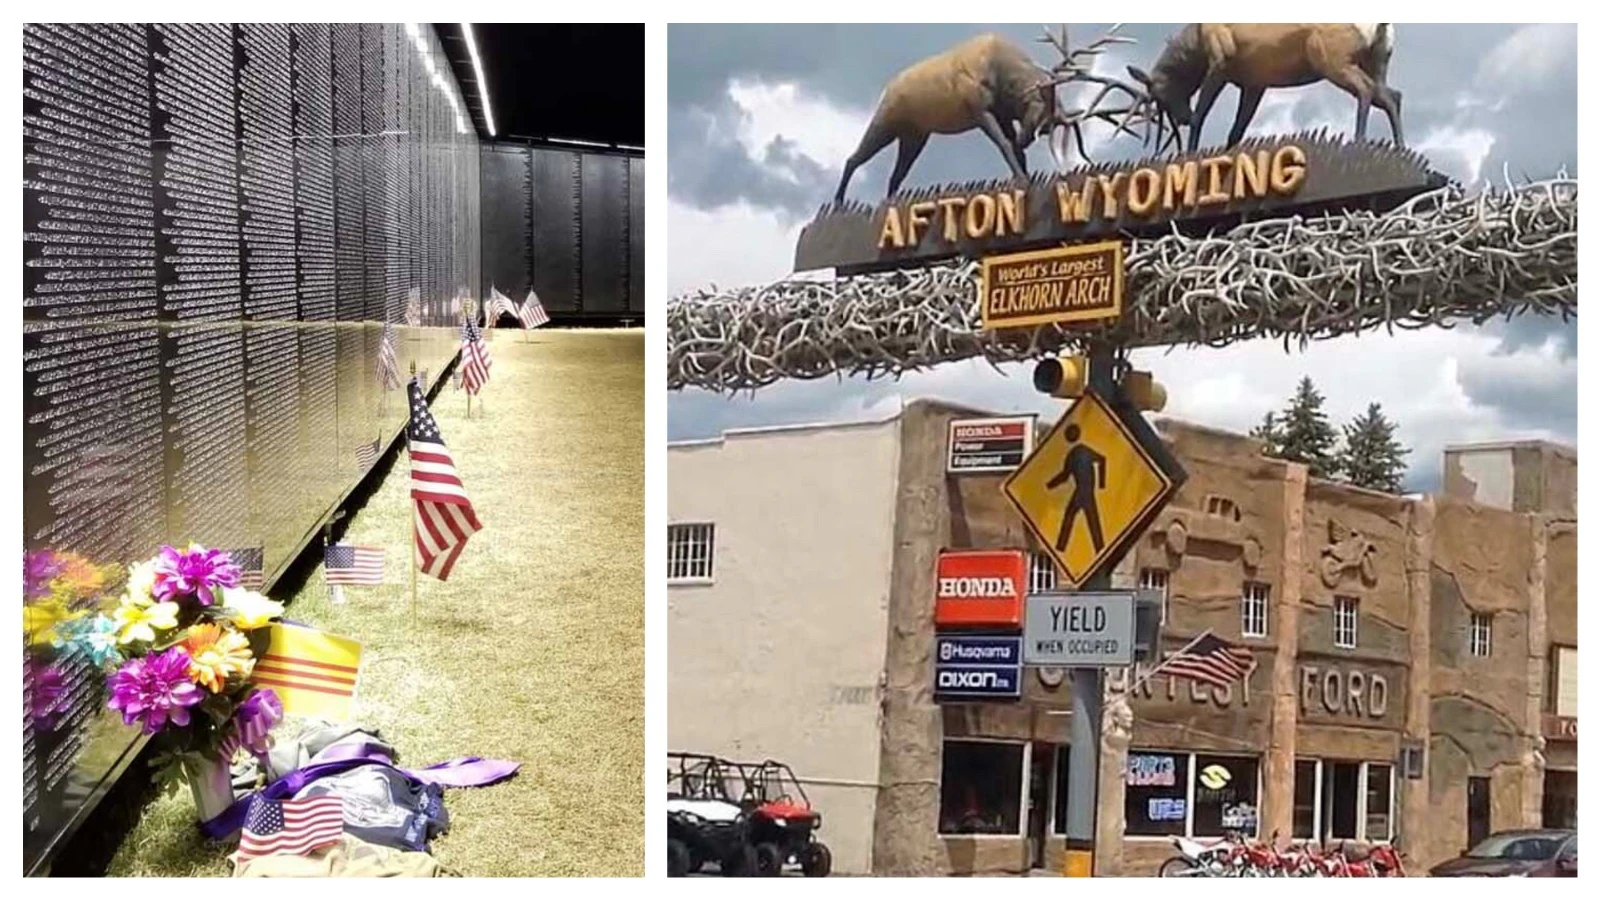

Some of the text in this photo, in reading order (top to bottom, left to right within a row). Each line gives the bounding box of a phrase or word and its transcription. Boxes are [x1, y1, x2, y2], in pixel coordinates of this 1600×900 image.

[877, 144, 1307, 250] AFTON WYOMING
[998, 256, 1104, 282] World's Largest
[990, 275, 1112, 314] ELKHORN ARCH
[955, 425, 1004, 438] HONDA
[938, 577, 1017, 598] HONDA
[1050, 605, 1107, 632] YIELD
[1036, 639, 1119, 654] WHEN OCCUPIED
[1300, 665, 1388, 718] FORD
